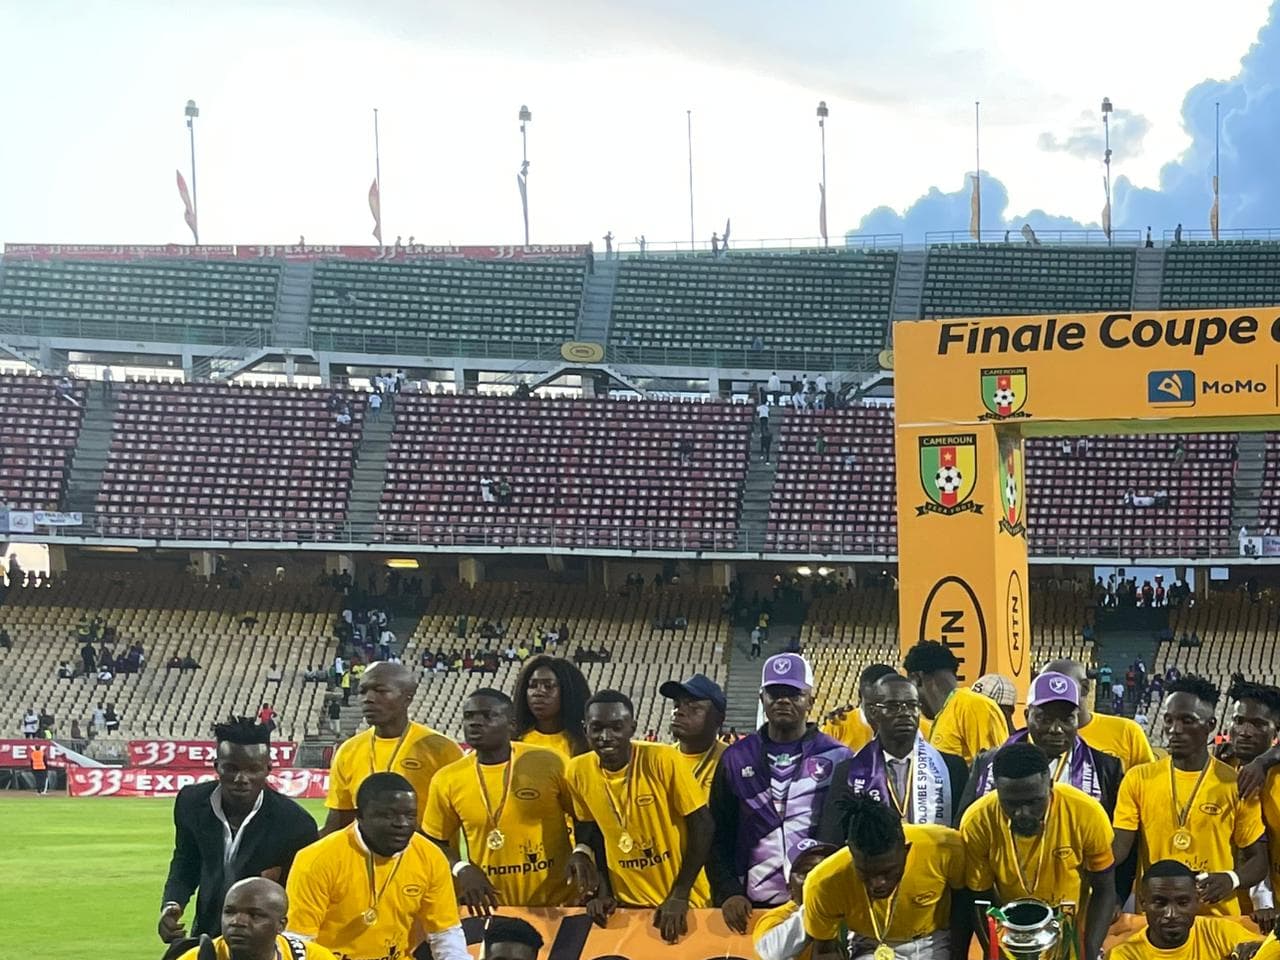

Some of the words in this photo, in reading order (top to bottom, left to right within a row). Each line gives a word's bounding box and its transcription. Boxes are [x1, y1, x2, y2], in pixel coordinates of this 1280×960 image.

[937, 319, 1086, 355] Finale
[1099, 313, 1258, 356] Coupe
[1201, 380, 1267, 395] MoMo
[923, 436, 973, 445] CAMEROUN
[1011, 596, 1019, 651] MTN
[941, 610, 966, 682] TN
[188, 745, 294, 760] EXRT
[917, 784, 927, 824] OLOMBE
[618, 851, 672, 873] ampion
